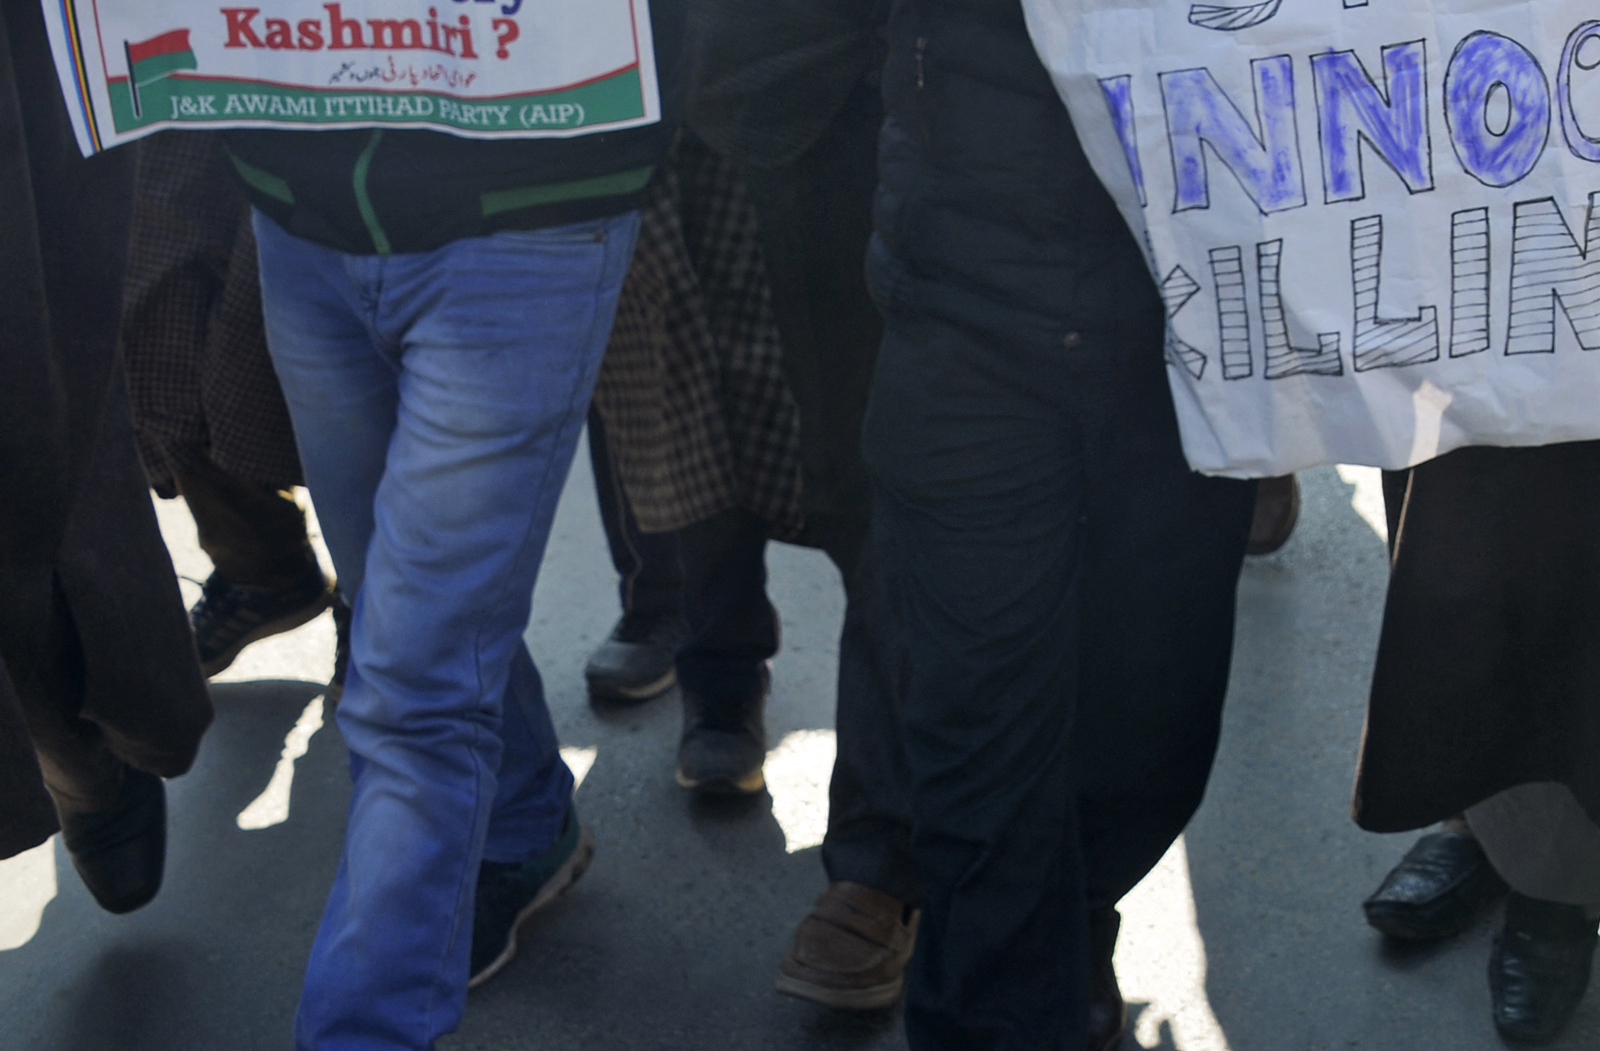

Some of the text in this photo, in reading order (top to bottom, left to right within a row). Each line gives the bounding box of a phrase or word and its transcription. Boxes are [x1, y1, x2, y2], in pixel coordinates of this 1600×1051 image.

[220, 4, 520, 60] Kashmiri ?
[170, 95, 585, 126] J&K AWAMI ITTIHAD PARTY (AIP)
